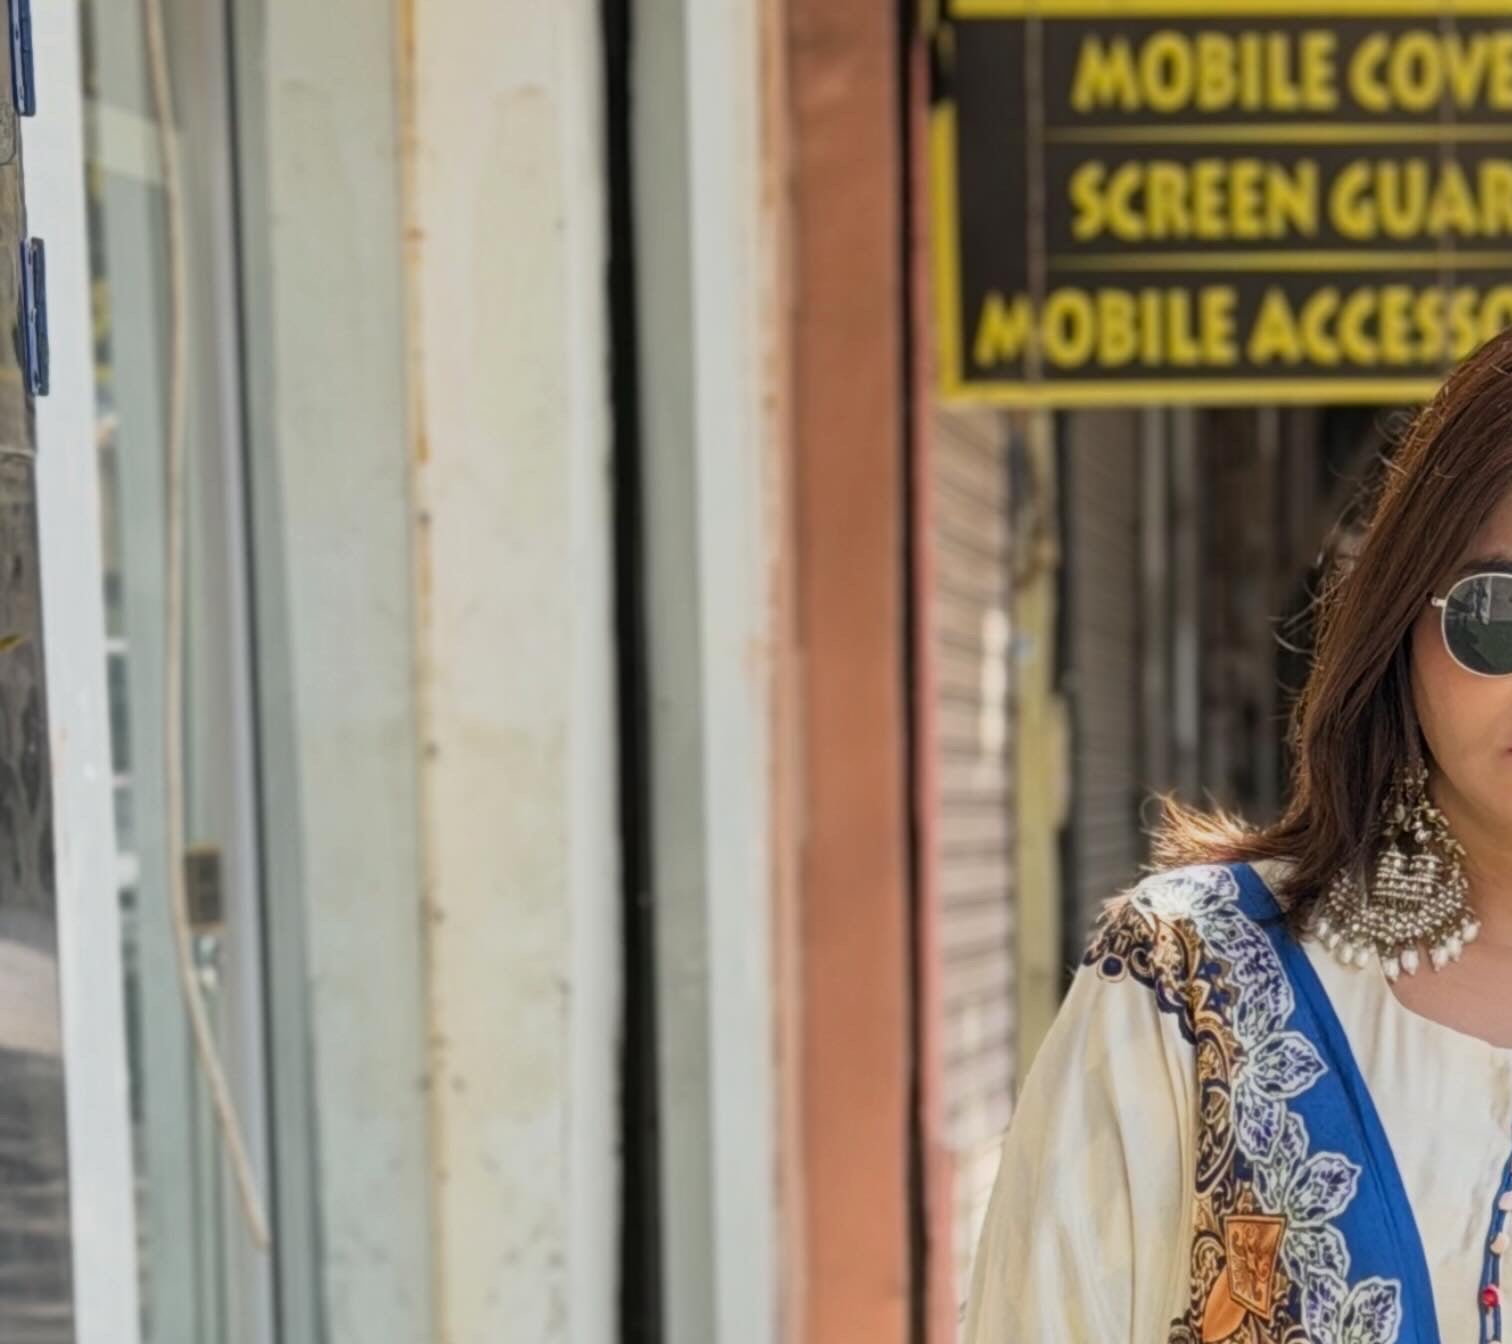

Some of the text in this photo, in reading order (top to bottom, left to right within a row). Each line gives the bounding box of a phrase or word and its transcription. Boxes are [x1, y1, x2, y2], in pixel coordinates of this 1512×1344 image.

[1070, 30, 1338, 112] MOBILE
[1068, 159, 1319, 241] SCREEN
[974, 286, 1239, 368] MOBILE
